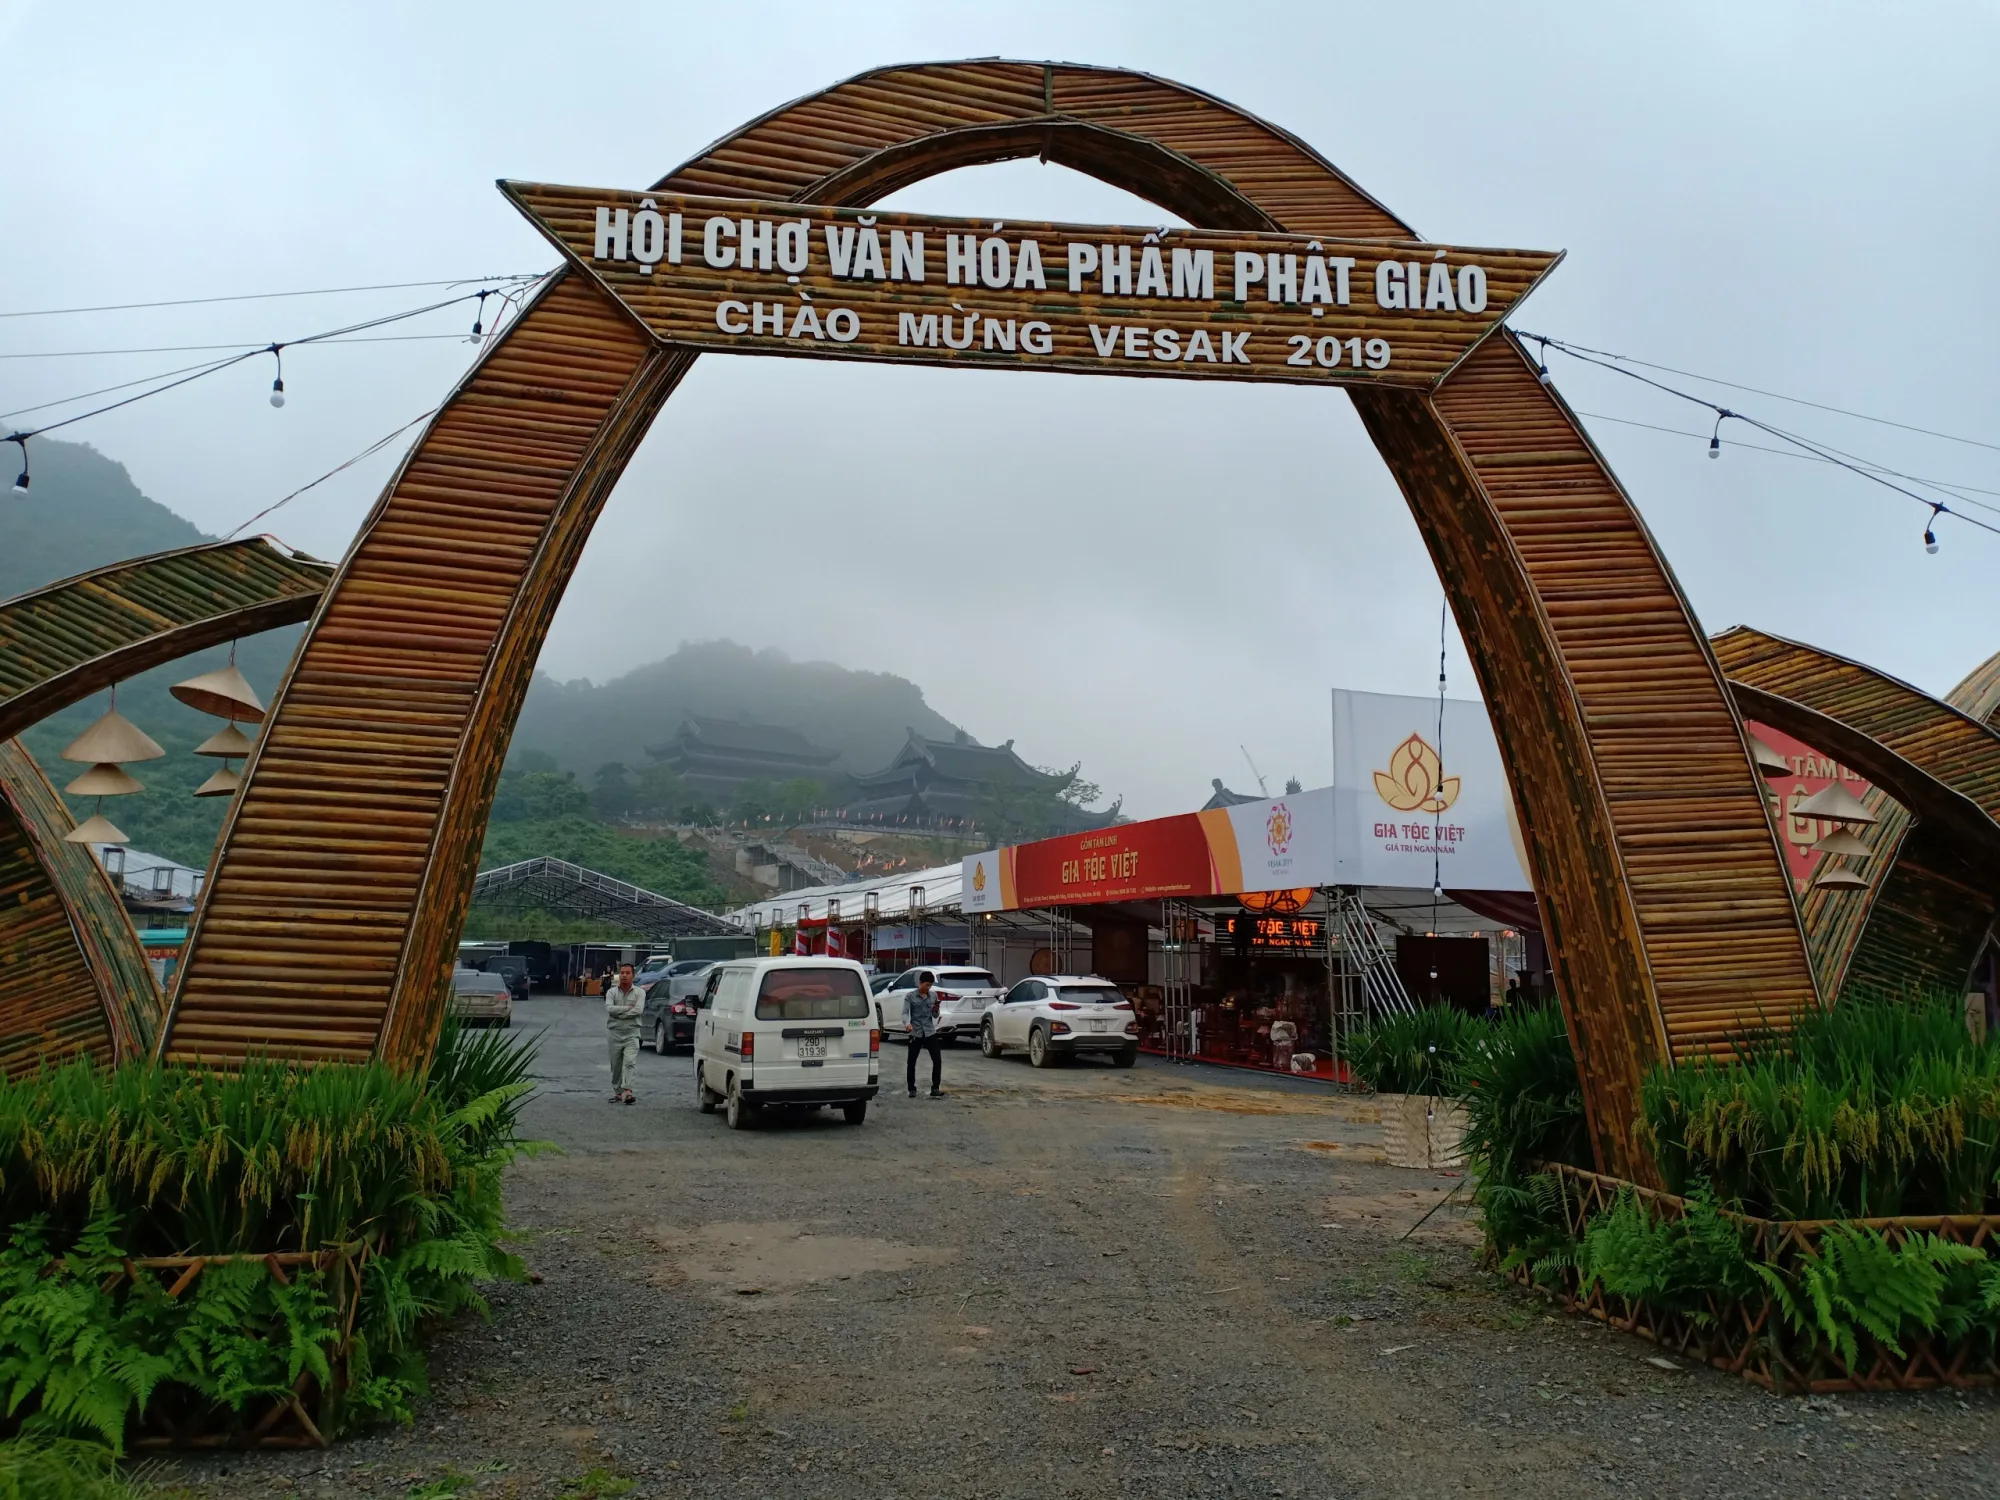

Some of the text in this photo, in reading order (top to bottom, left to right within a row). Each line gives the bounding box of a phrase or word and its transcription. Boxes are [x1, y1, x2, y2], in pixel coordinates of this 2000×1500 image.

[594, 198, 1488, 318] HỘI CHỢ VĂN HÓA PHẨM PHẬT GIÁO
[715, 292, 1392, 369] CHÀO MỪNG VESAK 2019
[1792, 752, 1838, 779] TÂM
[1374, 822, 1465, 844] GIA TỘC VIỆT
[1062, 847, 1138, 886] GIA TỘC VIỆT
[805, 1037, 820, 1047] 29D
